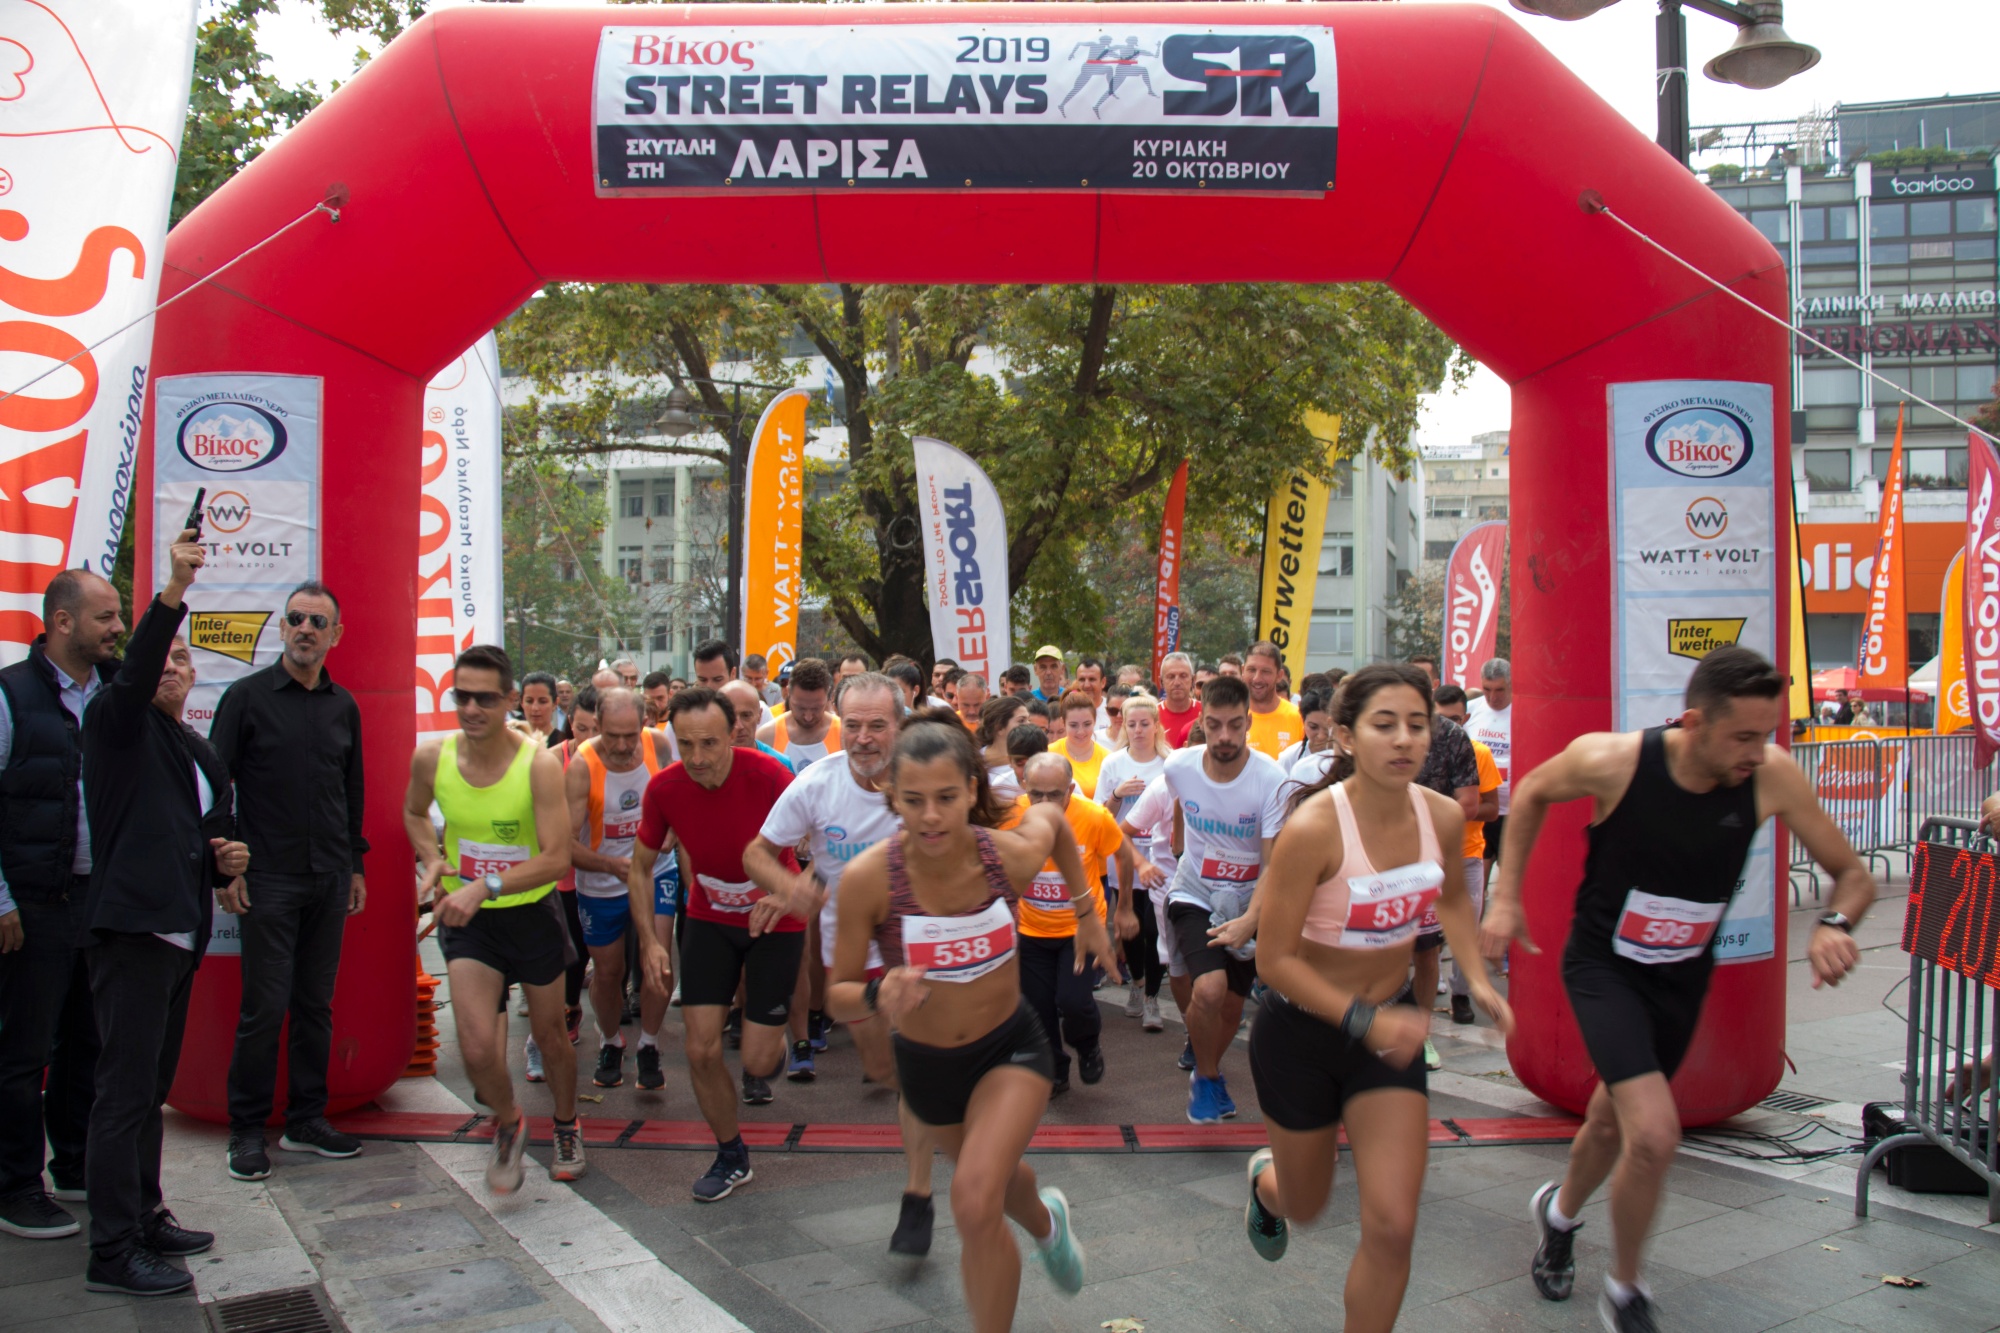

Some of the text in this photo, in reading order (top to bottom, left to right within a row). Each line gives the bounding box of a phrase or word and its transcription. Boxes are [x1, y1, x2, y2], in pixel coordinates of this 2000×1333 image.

[628, 34, 756, 72] Βίκος
[956, 35, 1050, 64] 2019
[1162, 34, 1320, 118] SR
[624, 74, 1048, 116] STREET RELAYS
[626, 138, 716, 156] ΣΚΥΤΑΛΗ
[729, 138, 928, 179] ΛΑΡΙΣΑ
[1133, 139, 1227, 158] ΚΥΡΙΑΚΗ
[626, 161, 665, 179] ΣΤΗ
[1132, 161, 1291, 180] 20 ΟΚΤΩΒΡΙΟΥ
[1891, 175, 1975, 195] bamboo
[1794, 295, 1885, 313] ΚΛΙΝΙΚΗ
[176, 392, 289, 419] ΦΥΣΙΚΟ ΜΕΤΑΛΛΙΚΟ ΝΕΡΟ
[1643, 397, 1754, 424] ΦΥΣΙΚΟ ΜΕΤΑΛΛΙΚΟ ΝΕΡΟ
[193, 434, 259, 460] Βίκος
[1667, 440, 1733, 466] Βίκος
[1270, 474, 1308, 664] erwetten
[194, 613, 231, 631] inter
[1674, 620, 1712, 638] inter
[199, 631, 253, 644] wetten
[1186, 812, 1256, 840] RUNNING
[1216, 862, 1250, 879] 527
[1033, 883, 1061, 899] 533
[1372, 894, 1422, 928] 537
[1424, 912, 1438, 925] 53
[934, 937, 992, 966] 538
[1714, 932, 1750, 948] ays.gr
